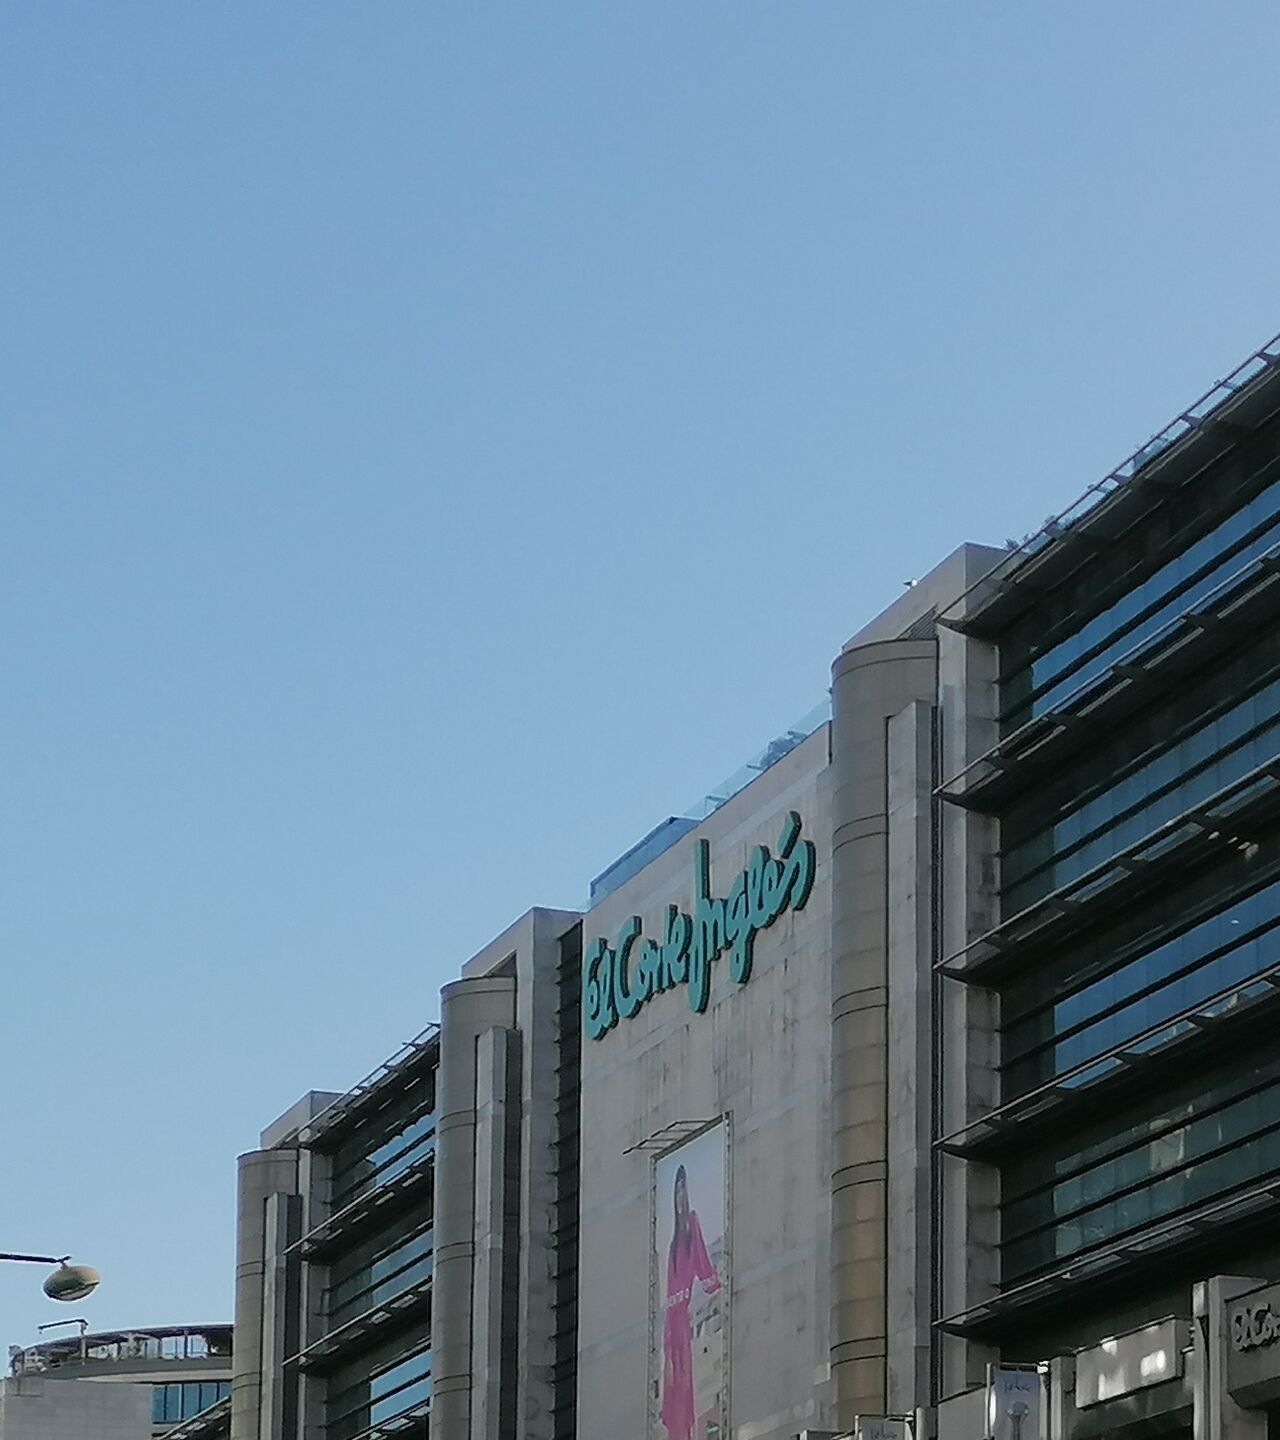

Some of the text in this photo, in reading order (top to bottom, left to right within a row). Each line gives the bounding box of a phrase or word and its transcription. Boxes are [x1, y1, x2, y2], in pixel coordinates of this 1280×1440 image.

[584, 810, 817, 1041] El Corte Inglés
